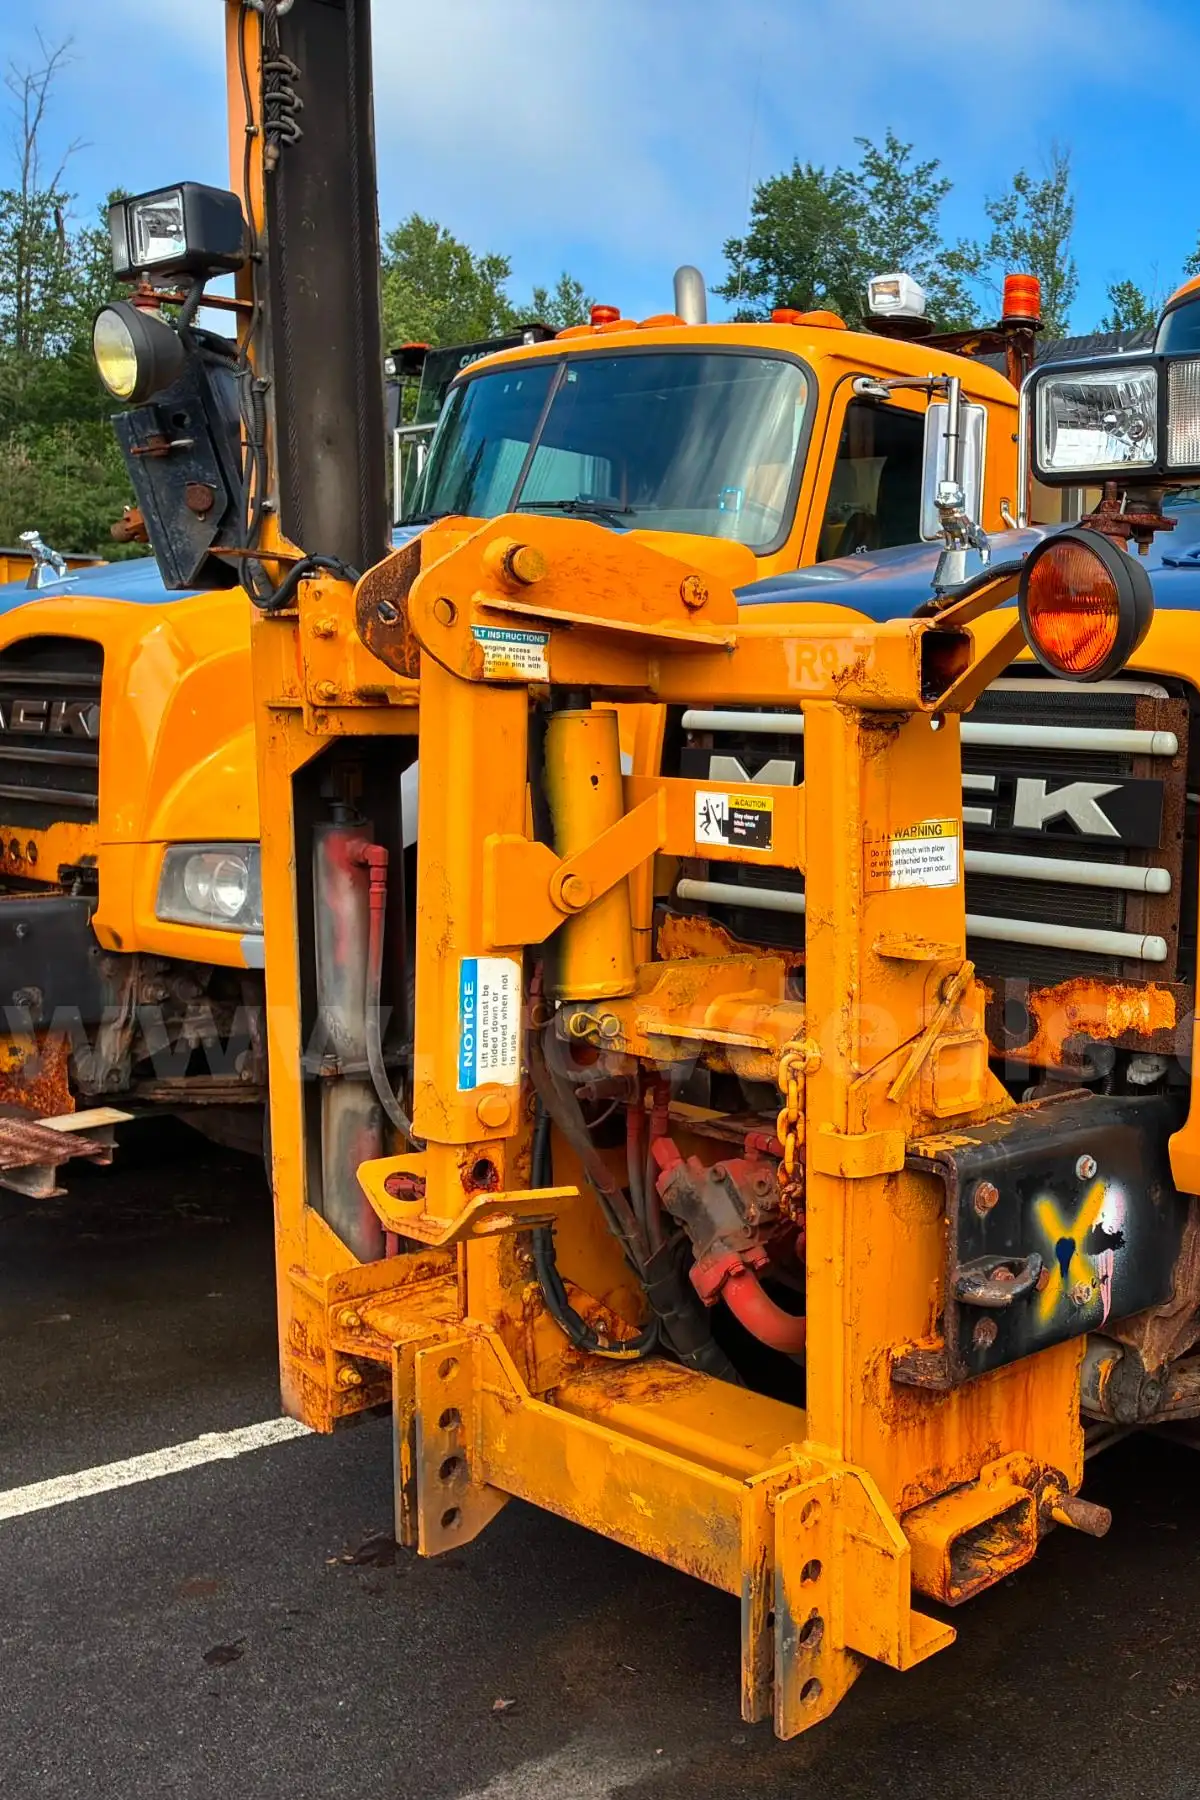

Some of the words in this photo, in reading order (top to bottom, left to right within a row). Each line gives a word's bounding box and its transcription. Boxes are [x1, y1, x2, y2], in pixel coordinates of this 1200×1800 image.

[472, 628, 486, 638] ILT
[487, 631, 545, 643] INSTRUCTIONS
[740, 799, 767, 809] CAUTION
[894, 823, 943, 839] WARNING
[918, 845, 931, 853] with
[931, 844, 945, 853] plow
[879, 860, 893, 868] wing
[895, 857, 920, 866] attached
[905, 867, 922, 877] injury
[501, 974, 509, 991] not
[481, 984, 490, 997] be
[492, 991, 499, 1002] or
[463, 981, 475, 1068] NOTICE
[491, 1006, 499, 1033] down
[480, 1052, 489, 1069] Lift
